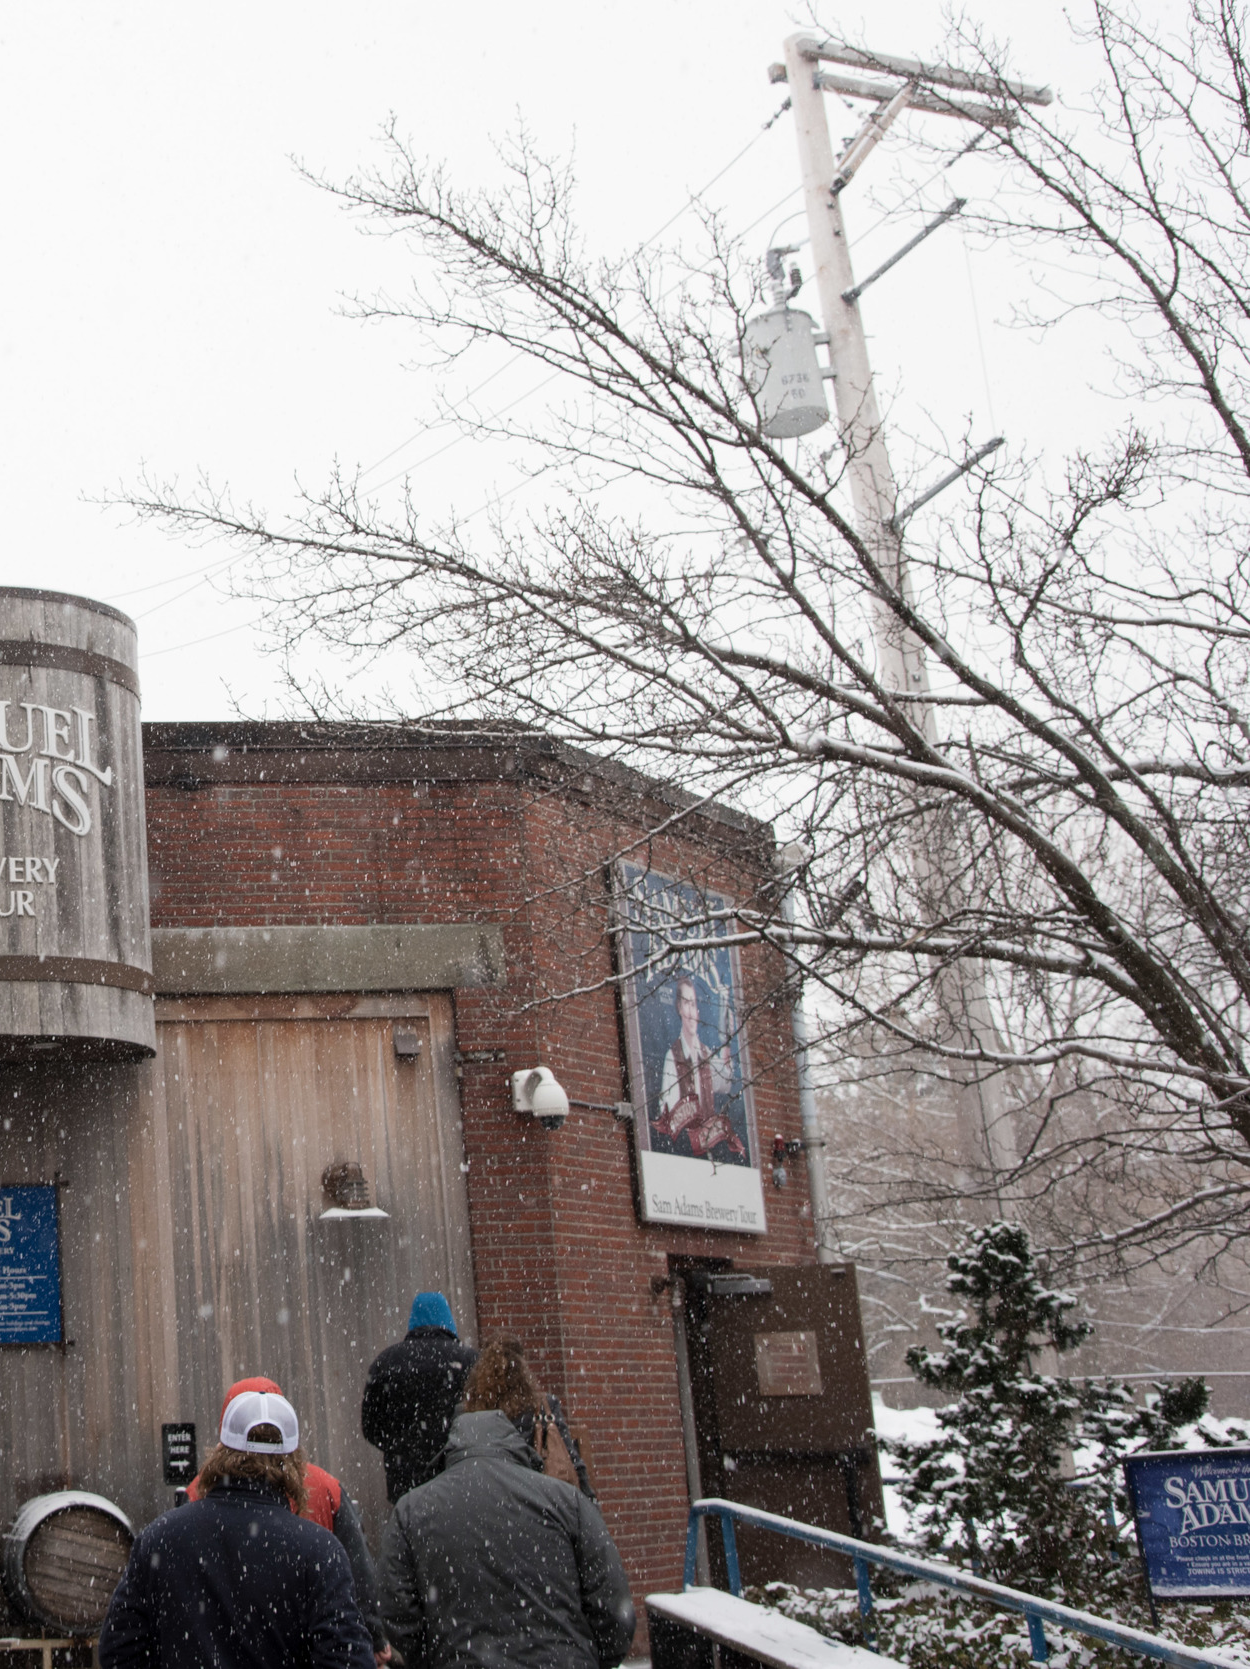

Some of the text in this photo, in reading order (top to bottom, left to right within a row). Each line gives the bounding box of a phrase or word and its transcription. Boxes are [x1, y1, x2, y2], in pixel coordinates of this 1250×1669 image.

[651, 1194, 757, 1225] Sam Adams Brewery Tour
[2, 1265, 27, 1275] Hours
[167, 1433, 192, 1442] ENTER
[170, 1445, 190, 1454] HERE
[1170, 1534, 1231, 1548] BOSTON
